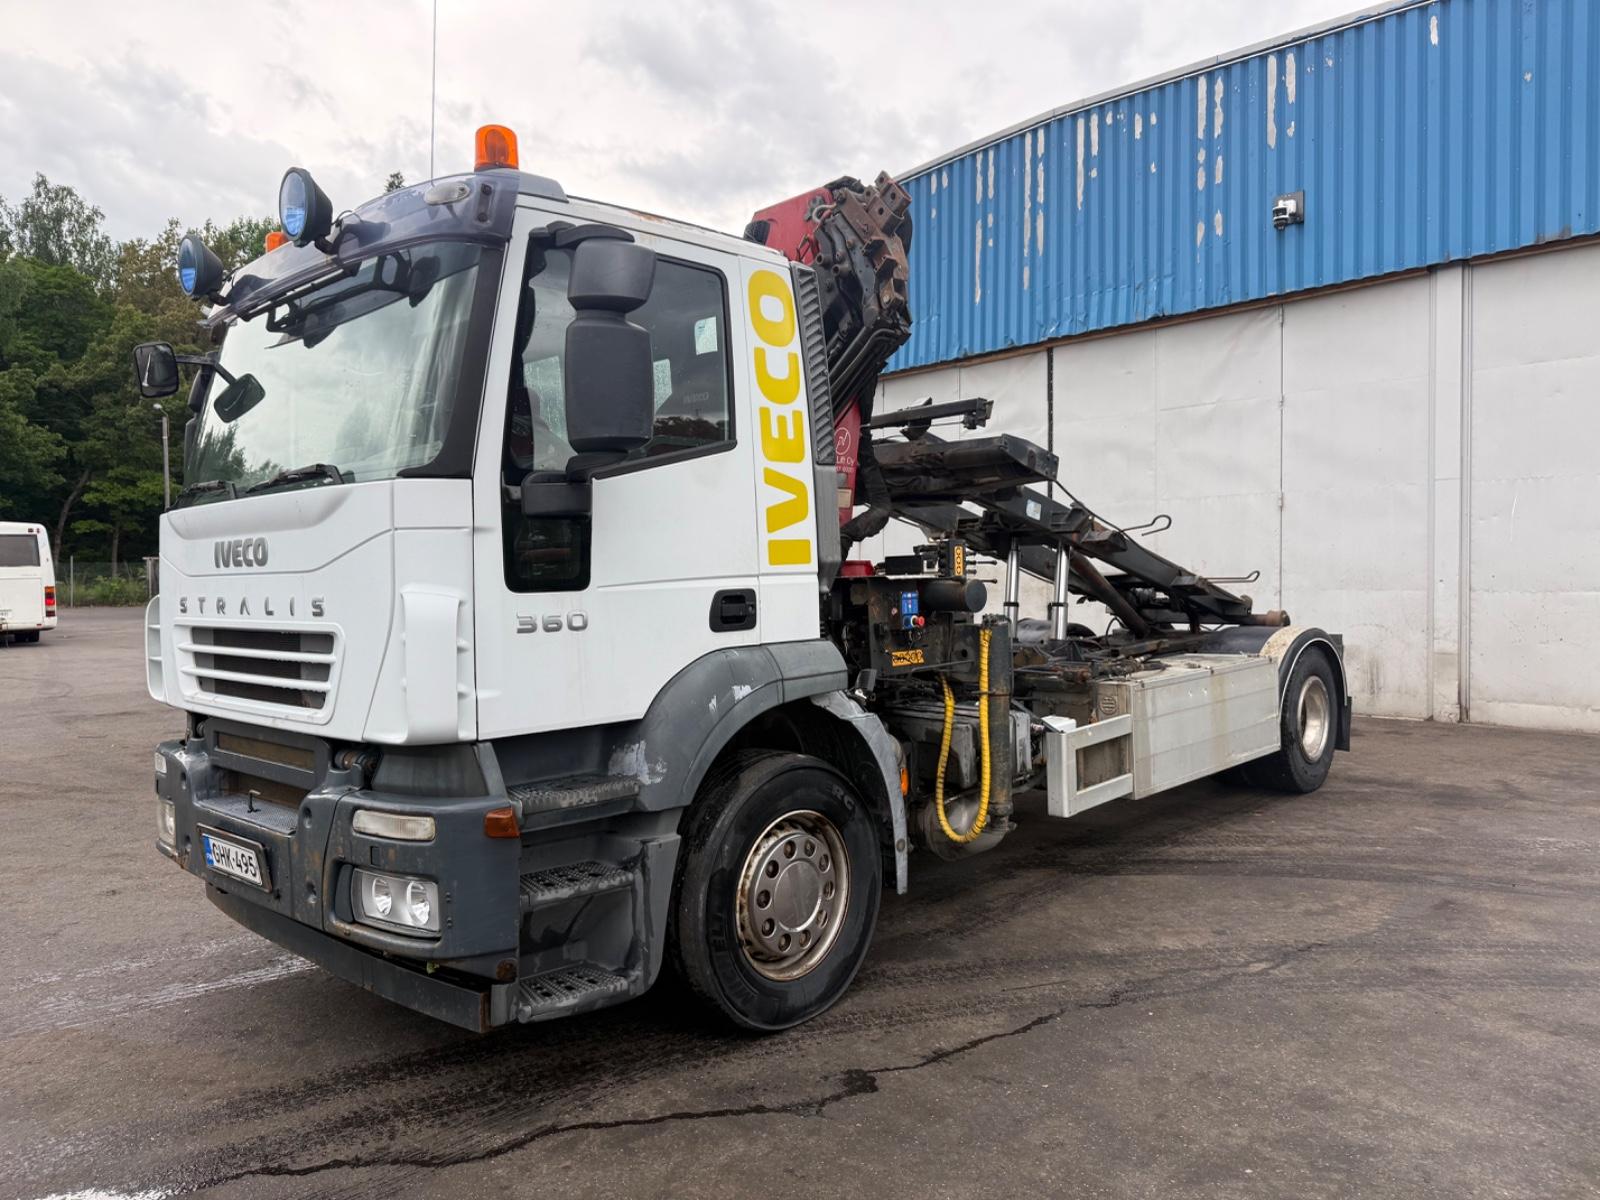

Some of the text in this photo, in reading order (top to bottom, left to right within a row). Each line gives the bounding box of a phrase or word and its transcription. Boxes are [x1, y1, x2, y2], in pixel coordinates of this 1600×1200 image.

[748, 269, 811, 566] IVECO
[214, 537, 269, 569] IVECO
[179, 596, 325, 617] STRALIS
[516, 609, 589, 634] 360
[212, 842, 257, 878] GHK-495
